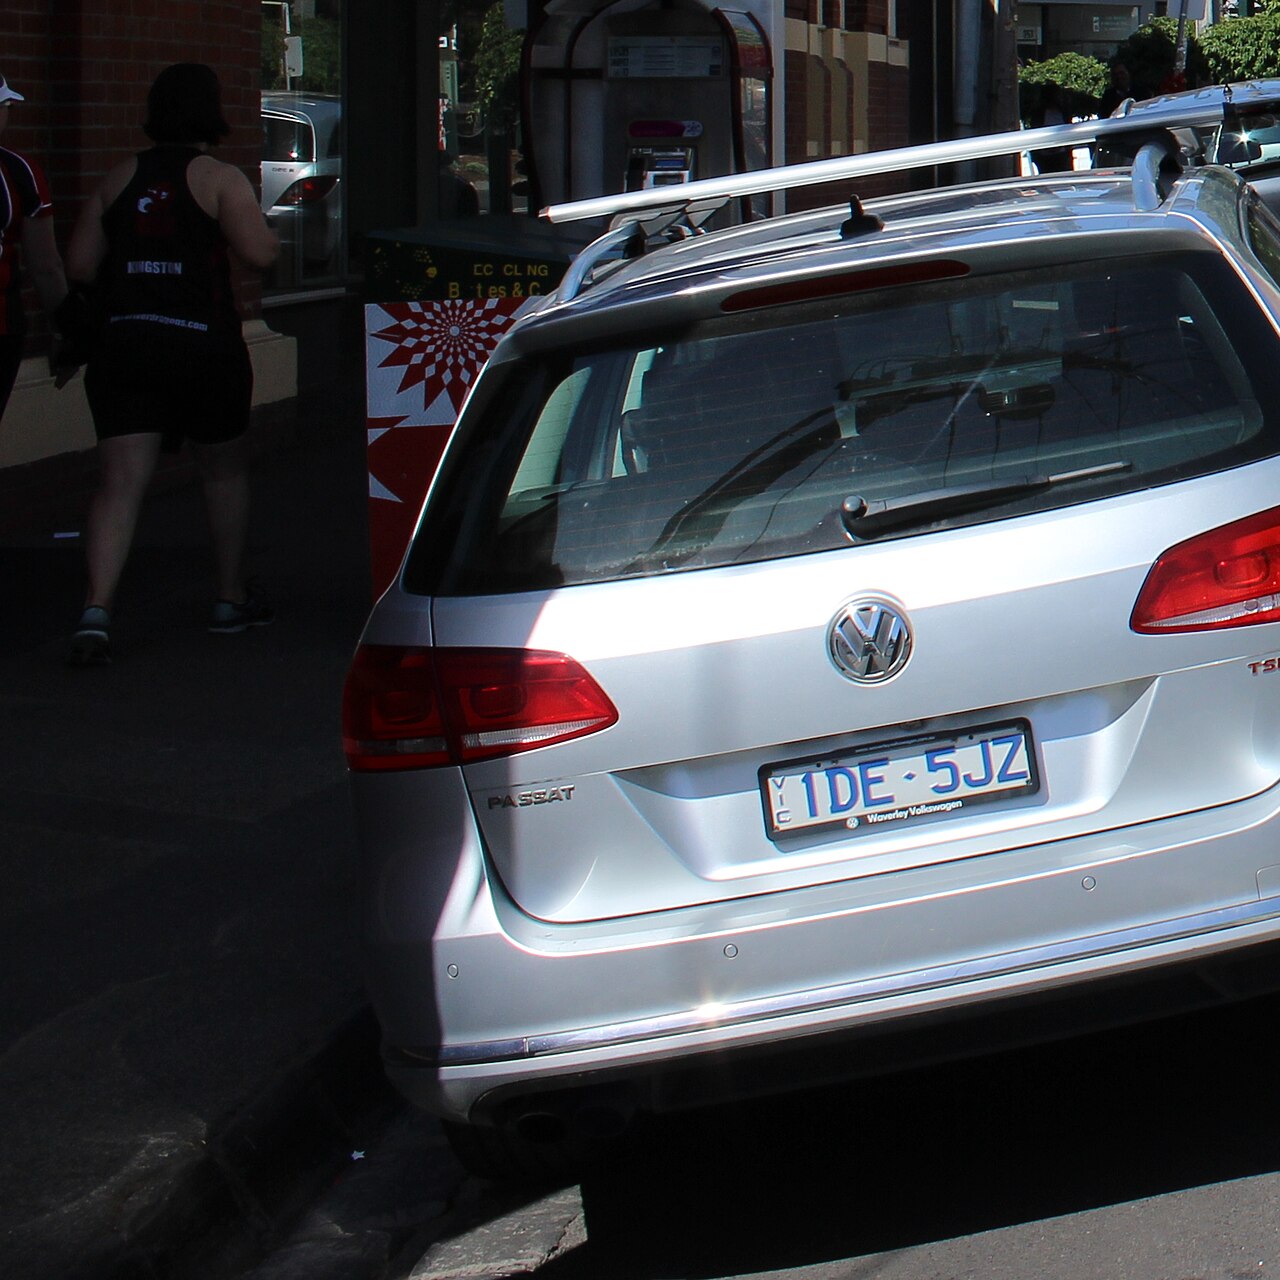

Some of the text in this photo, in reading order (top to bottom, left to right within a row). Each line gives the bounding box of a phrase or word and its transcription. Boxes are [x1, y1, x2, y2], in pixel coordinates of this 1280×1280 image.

[127, 260, 183, 276] KINGSTON
[488, 784, 575, 810] PASSAT
[867, 799, 963, 824] Waverley Volkswagen
